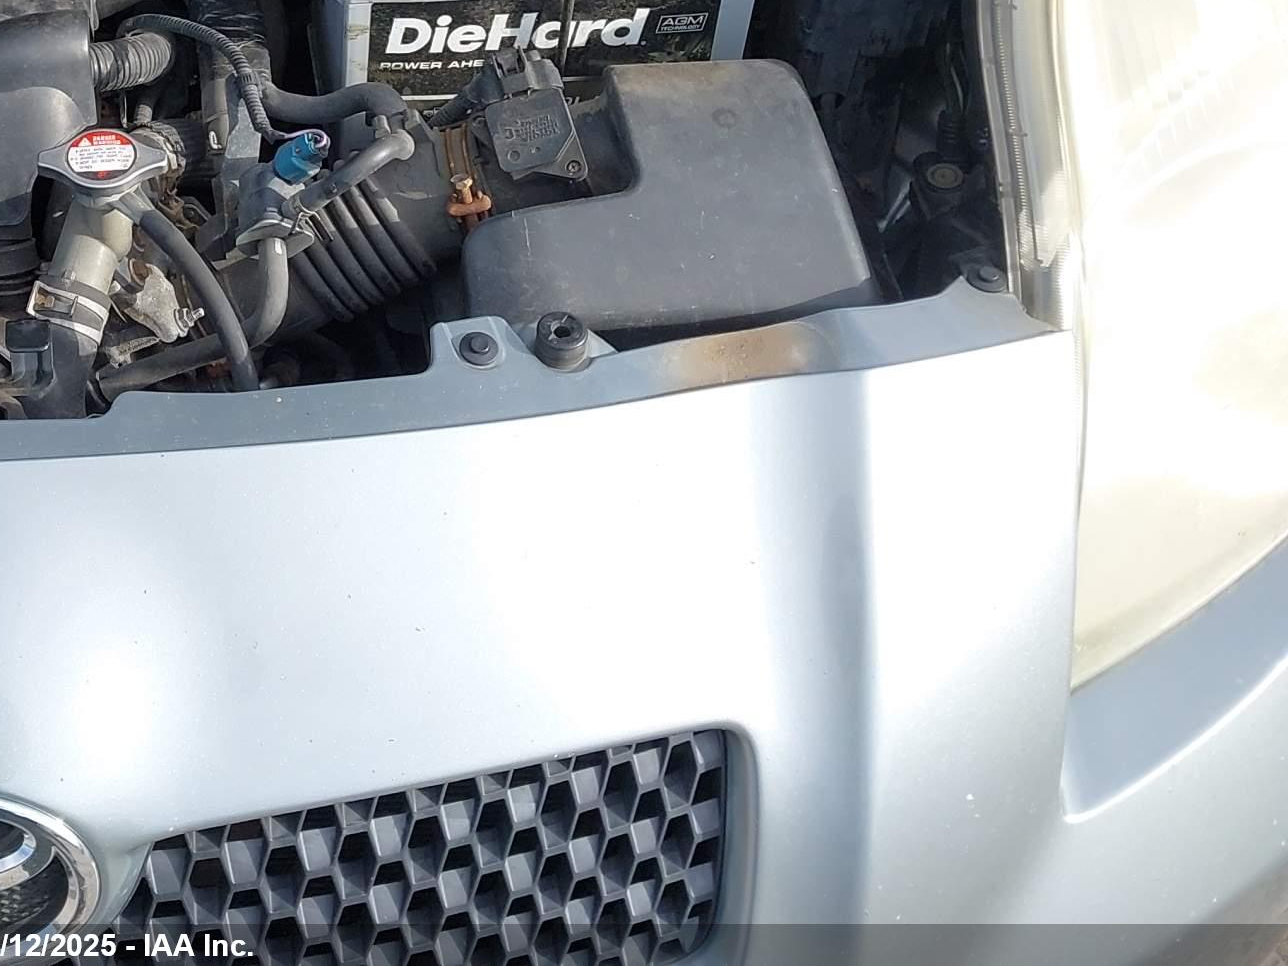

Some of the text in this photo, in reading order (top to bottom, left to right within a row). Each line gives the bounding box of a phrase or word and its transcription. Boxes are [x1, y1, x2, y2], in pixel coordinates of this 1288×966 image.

[662, 15, 705, 26] AGM
[384, 7, 650, 54] DieHard
[379, 59, 485, 71] POWER AHE
